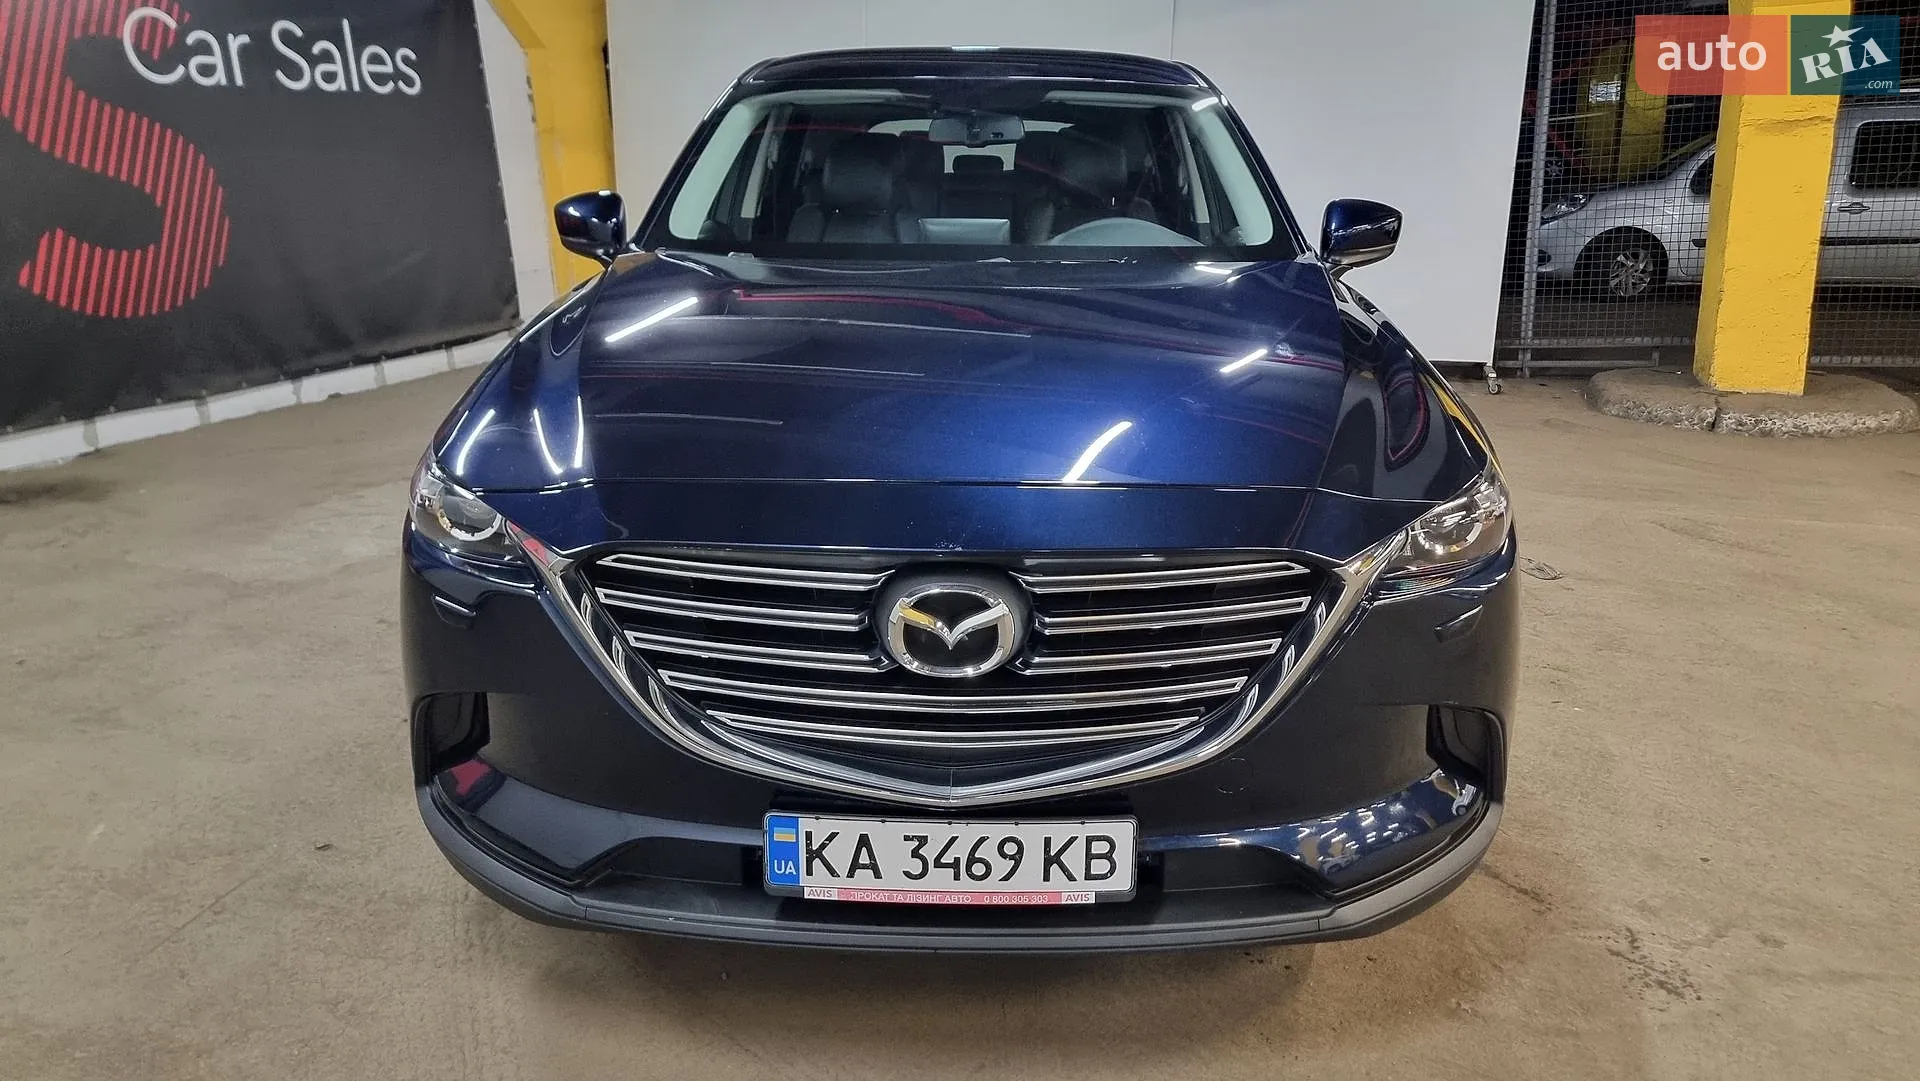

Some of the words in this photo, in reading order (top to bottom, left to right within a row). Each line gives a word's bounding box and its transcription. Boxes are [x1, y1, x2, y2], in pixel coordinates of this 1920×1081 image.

[122, 6, 250, 88] Car
[271, 18, 422, 95] Sales
[804, 830, 883, 879] KA
[902, 834, 1025, 882] 3469
[1042, 834, 1117, 882] KB
[774, 860, 797, 876] UA
[808, 889, 832, 898] AVIS
[892, 893, 905, 902] ТА
[944, 895, 972, 904] АВТО
[993, 895, 1009, 904] 800
[1065, 893, 1090, 902] AVIS
